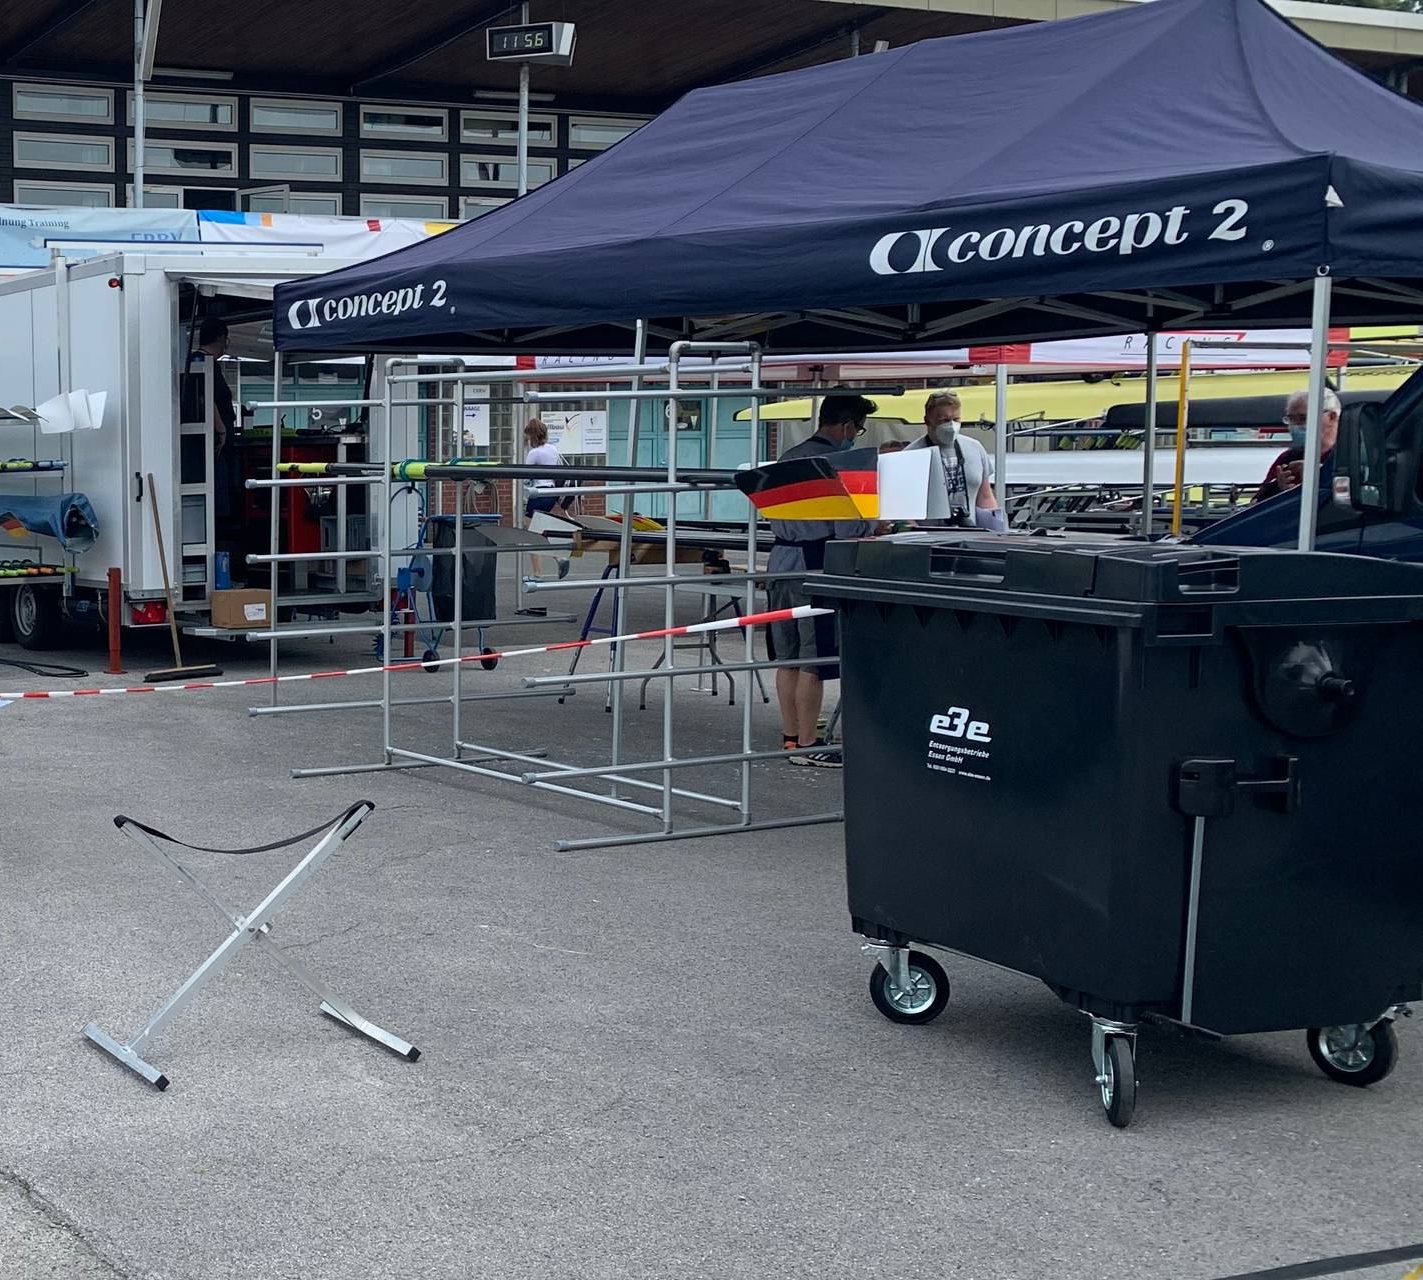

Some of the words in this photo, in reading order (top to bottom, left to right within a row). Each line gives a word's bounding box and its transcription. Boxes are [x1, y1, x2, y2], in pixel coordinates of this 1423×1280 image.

[28, 219, 70, 230] Training
[947, 205, 1190, 264] concept
[1207, 199, 1249, 240] 2
[324, 283, 425, 321] concept
[430, 280, 447, 307] 2
[929, 706, 992, 743] e3e
[928, 750, 945, 760] Essen
[946, 754, 964, 764] GmbH
